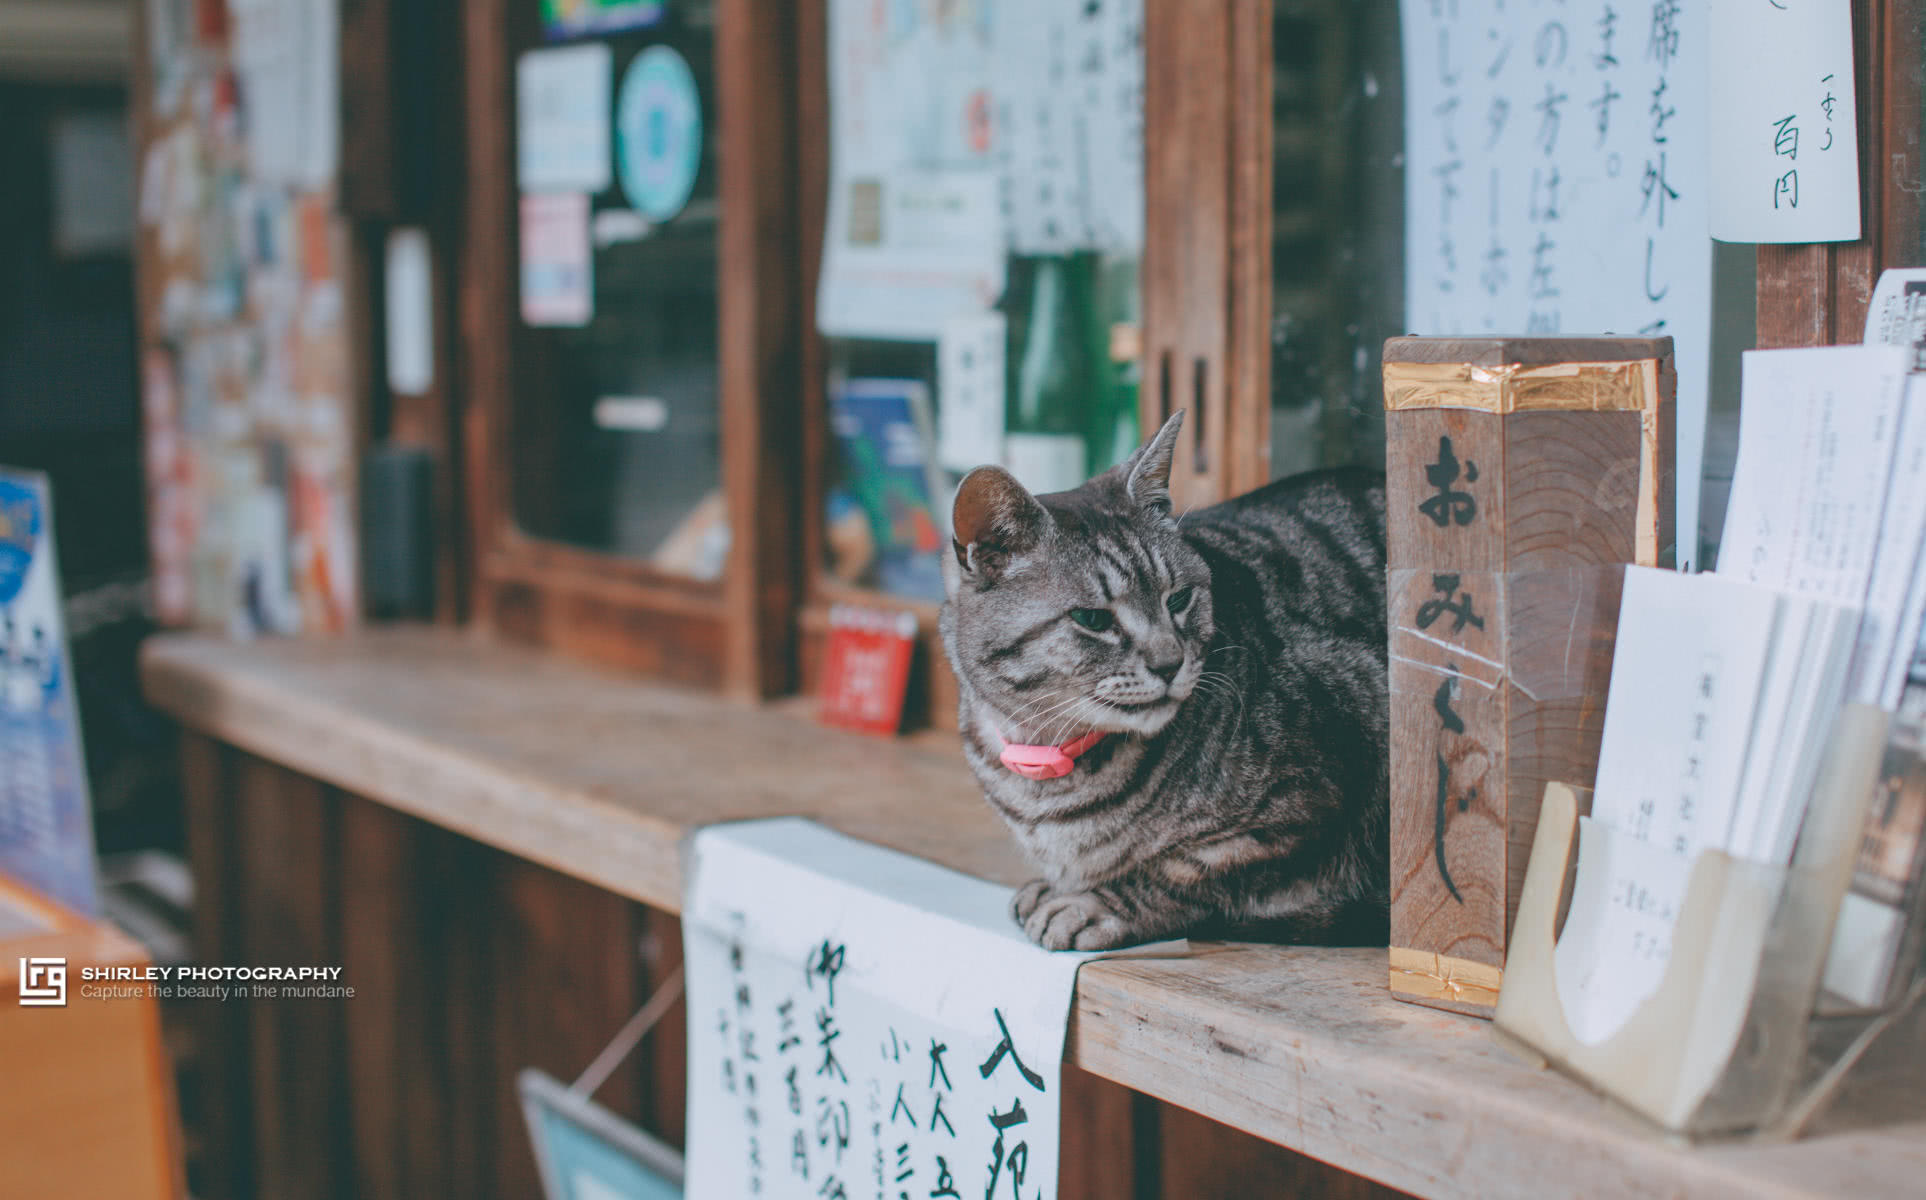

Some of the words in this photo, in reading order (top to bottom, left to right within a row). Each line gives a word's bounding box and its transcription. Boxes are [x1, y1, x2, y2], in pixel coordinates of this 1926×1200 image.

[1588, 4, 1622, 178] ます。
[1637, 0, 1681, 334] 席を外し
[1772, 115, 1800, 209] 百円
[1416, 436, 1484, 905] おみくじ
[880, 1026, 918, 1200] 小人三
